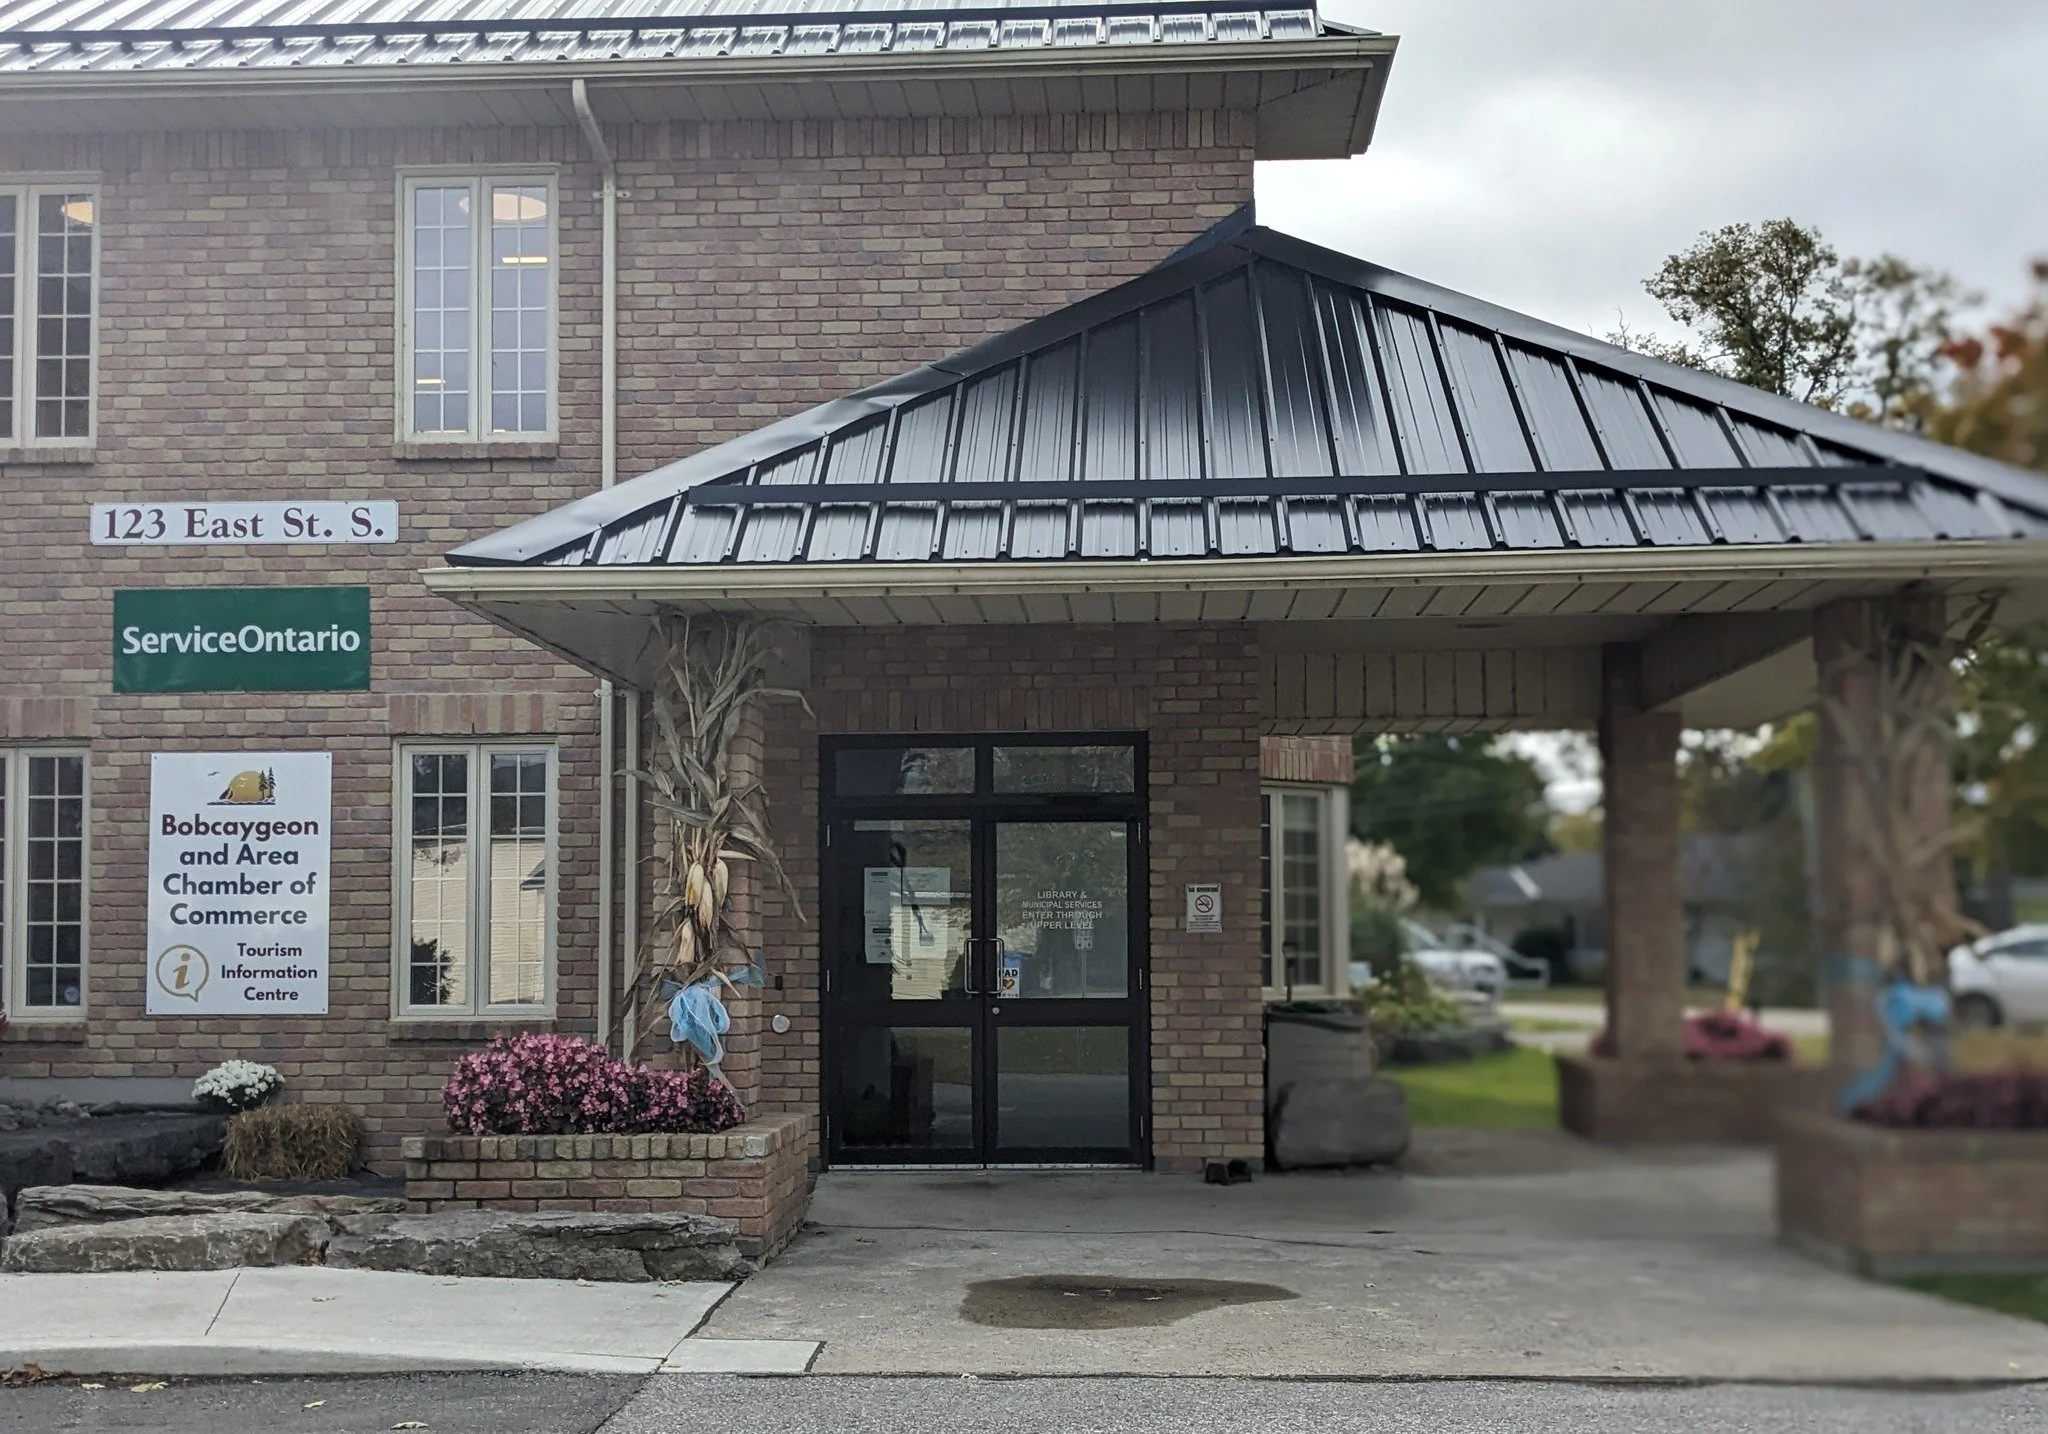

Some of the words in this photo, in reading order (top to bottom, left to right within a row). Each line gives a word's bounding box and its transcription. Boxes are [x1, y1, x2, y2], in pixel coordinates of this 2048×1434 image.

[104, 508, 167, 540] 123
[184, 507, 264, 539] East
[283, 506, 333, 538] St.
[350, 506, 385, 538] S.
[122, 624, 361, 655] ServiceOntario
[161, 813, 319, 842] Bobcaygeon
[179, 843, 229, 866] and
[235, 844, 299, 866] Area
[162, 872, 283, 896] Chamber
[289, 871, 318, 896] of
[1037, 890, 1078, 899] LIBRARY
[1080, 890, 1087, 899] &
[1022, 900, 1063, 909] MUNICIPAL
[1064, 900, 1103, 909] SERVICES
[169, 902, 308, 926] Commerce
[1022, 911, 1053, 919] ENTER
[1056, 911, 1102, 919] THROUGH
[1064, 921, 1094, 929] LEVEL
[236, 942, 303, 958] Tourism
[220, 964, 318, 979] Information
[243, 987, 299, 1001] Centre
